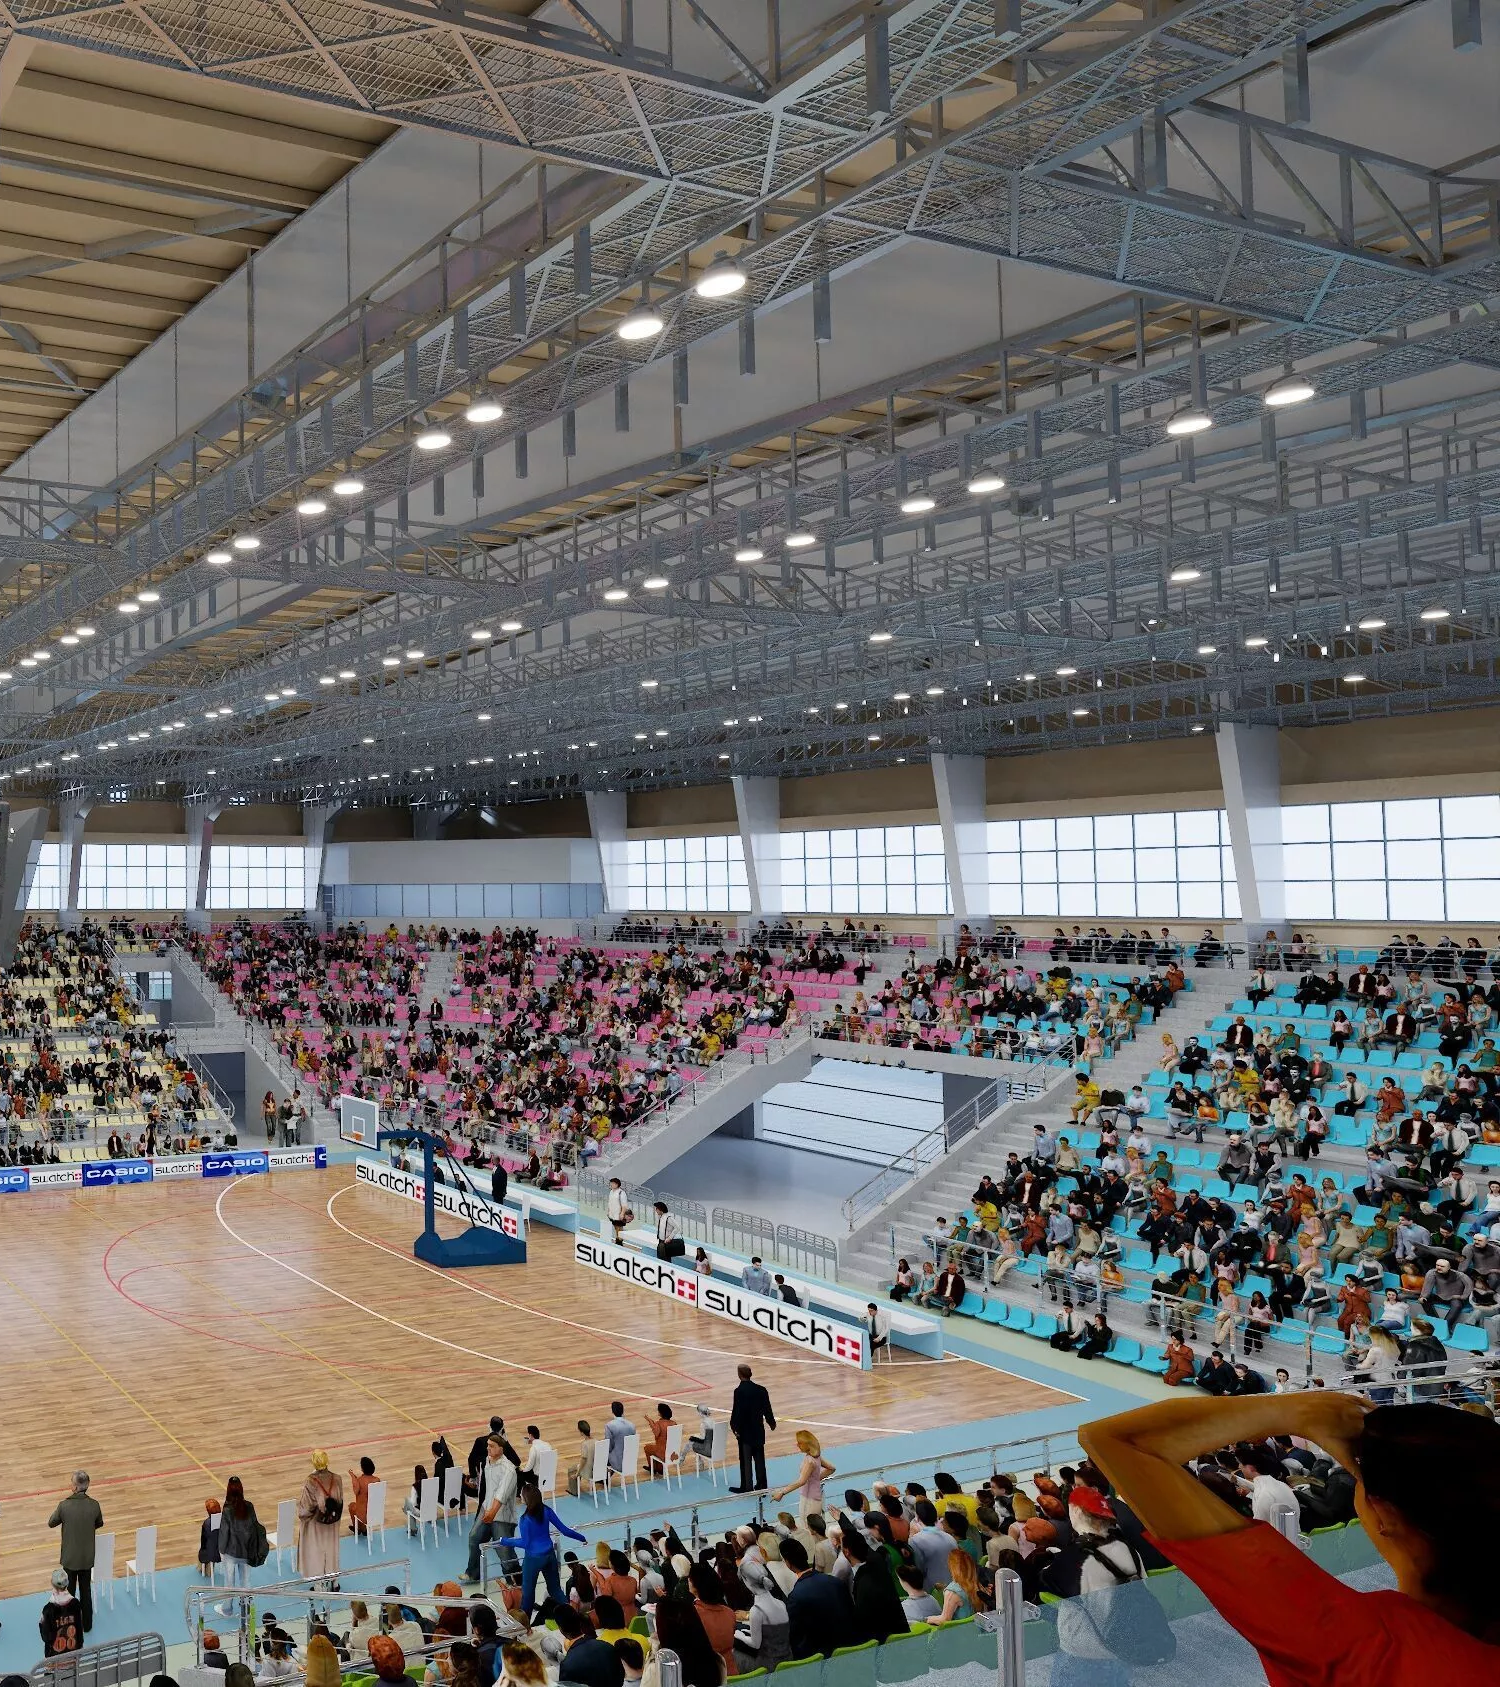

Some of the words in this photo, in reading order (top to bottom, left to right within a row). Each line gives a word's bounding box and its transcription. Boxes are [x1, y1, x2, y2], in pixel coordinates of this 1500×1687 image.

[86, 1166, 149, 1179] CASIO
[206, 1157, 265, 1170] CASIO
[356, 1164, 415, 1198] swatch
[576, 1242, 675, 1294] swatch
[704, 1289, 833, 1353] swatch
